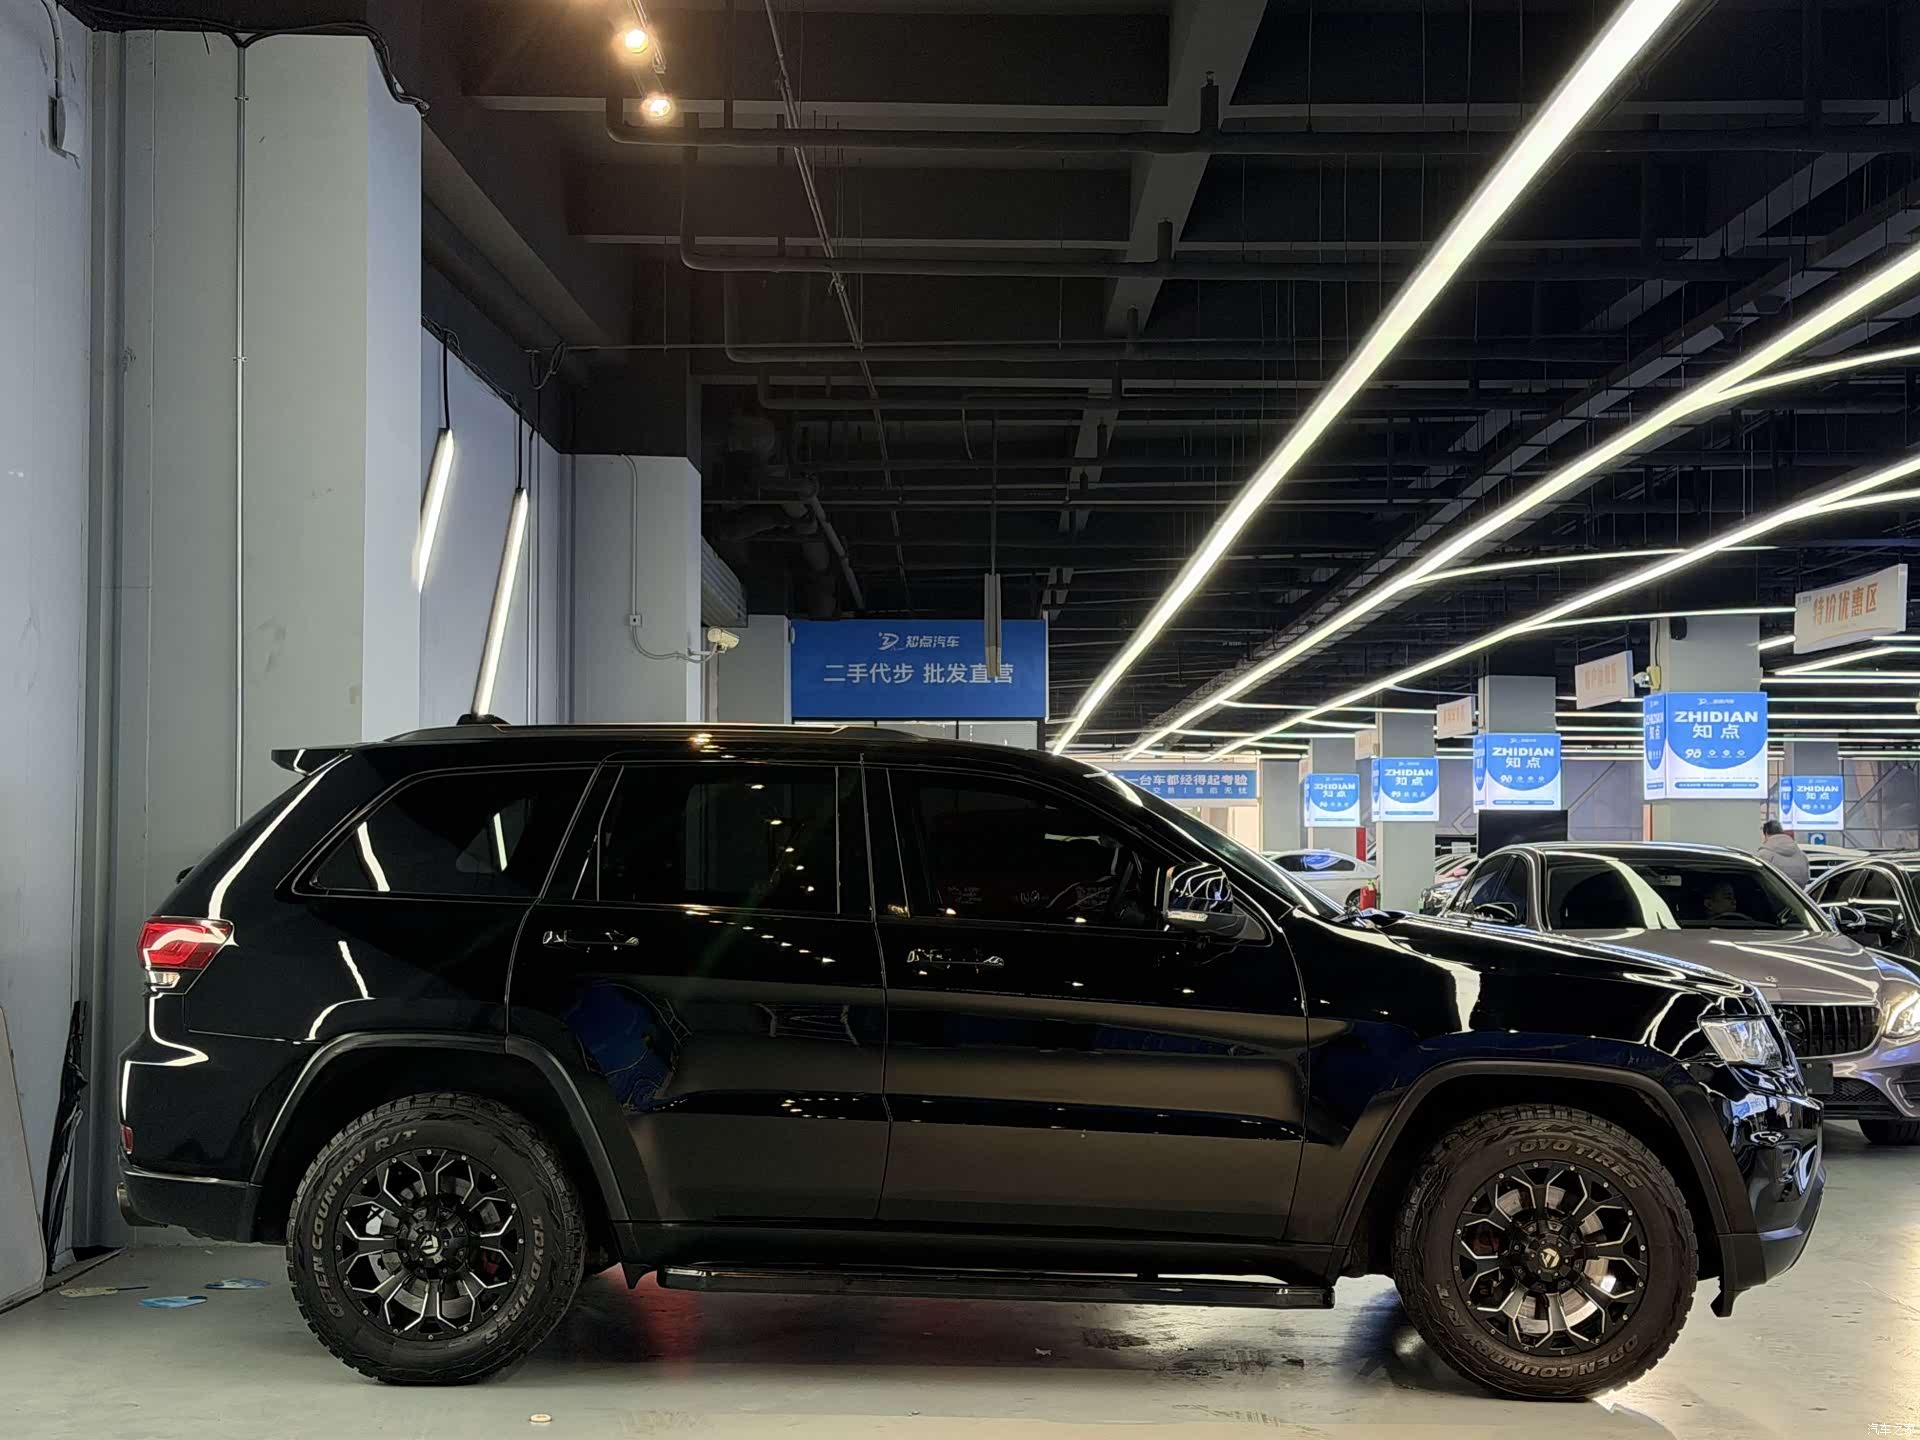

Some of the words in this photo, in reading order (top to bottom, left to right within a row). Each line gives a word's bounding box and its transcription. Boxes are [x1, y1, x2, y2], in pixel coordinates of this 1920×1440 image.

[1813, 582, 1879, 625] 特价优惠区
[905, 634, 961, 649] 知点汽车
[823, 663, 914, 684] 二手代步
[922, 663, 1014, 684] 批发直营
[1674, 711, 1759, 723] ZHIDIAN
[1692, 723, 1740, 739] 知点
[1491, 746, 1555, 757] ZHIDIAN
[1505, 756, 1541, 769] 知点
[1119, 774, 1248, 786] 一台车都经得起考验
[1383, 768, 1434, 777] ZHIDIAN
[1313, 782, 1356, 790] ZHIDIAN
[1394, 776, 1424, 787] 知点
[1796, 785, 1839, 793] ZHIDIAN
[1506, 1138, 1573, 1157] TOYO
[1574, 1143, 1644, 1189] TIRES
[311, 1148, 368, 1251] COUNTRY
[375, 1129, 418, 1153] R/T
[532, 1215, 544, 1281] TOYO
[484, 1282, 536, 1345] TIRES
[1463, 1332, 1576, 1379] COUNTRY
[1576, 1334, 1639, 1377] OPEN
